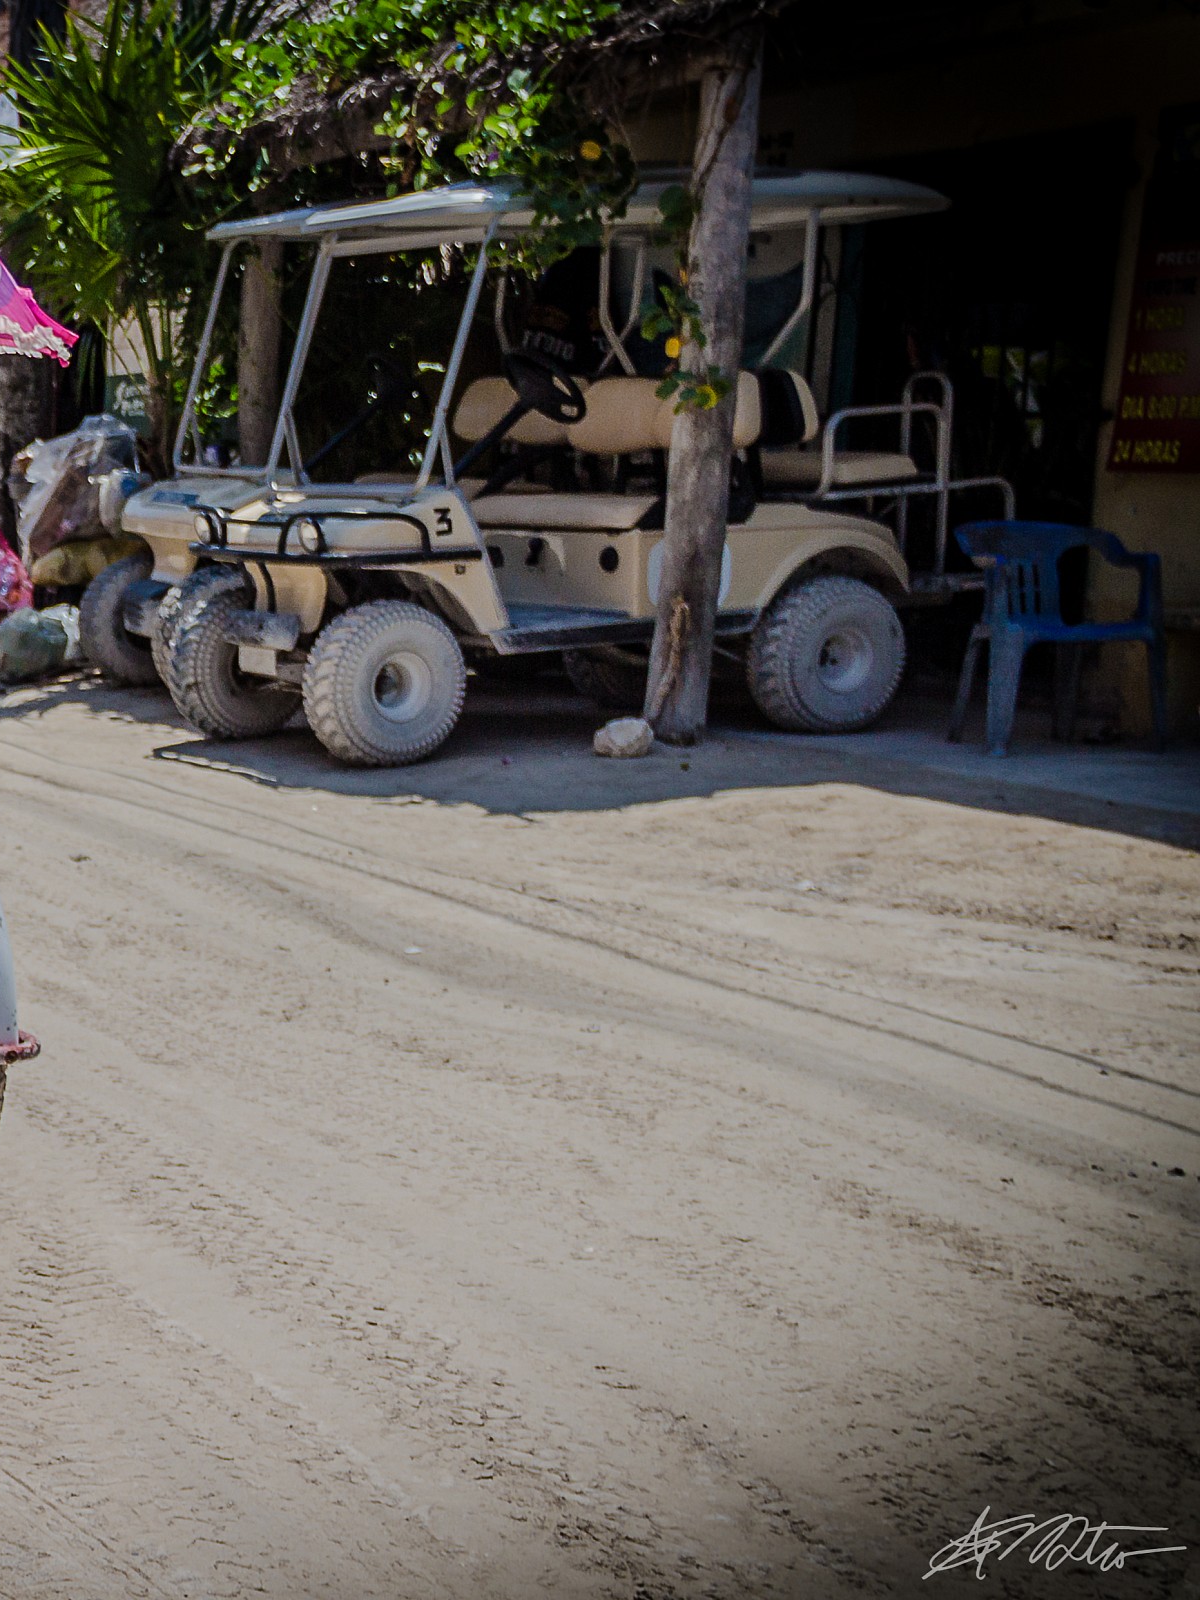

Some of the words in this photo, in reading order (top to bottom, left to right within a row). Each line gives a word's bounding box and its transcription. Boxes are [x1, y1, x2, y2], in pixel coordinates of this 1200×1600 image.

[1139, 350, 1187, 375] HORAS
[1112, 439, 1132, 463] 24
[1133, 438, 1182, 464] HORAS
[433, 507, 453, 537] 3
